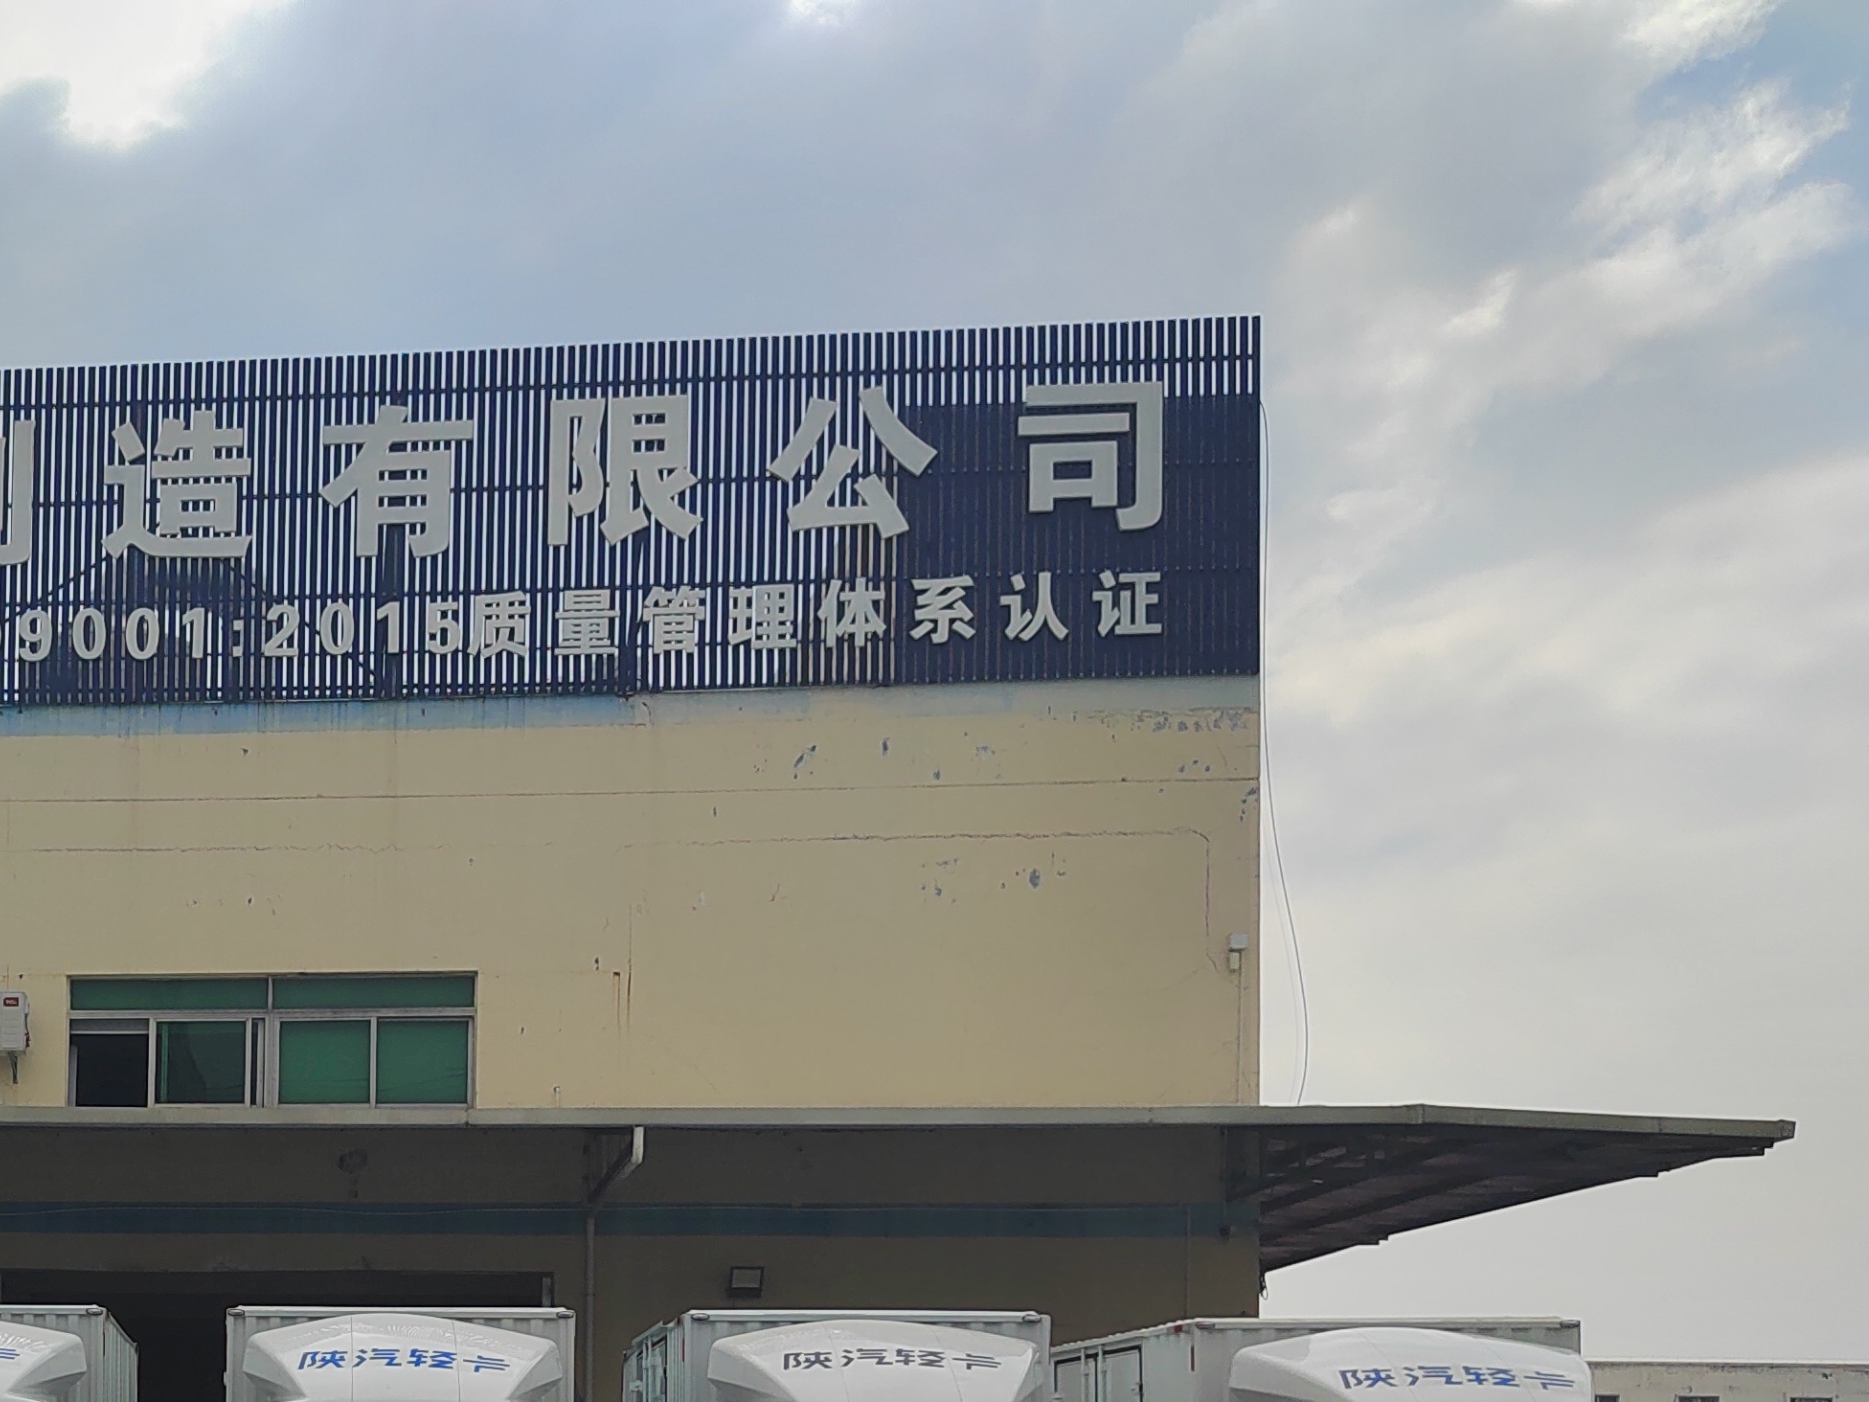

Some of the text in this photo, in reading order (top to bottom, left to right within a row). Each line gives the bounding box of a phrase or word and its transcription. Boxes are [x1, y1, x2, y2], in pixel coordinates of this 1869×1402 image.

[298, 1348, 510, 1372] 陕汽轻卡
[783, 1348, 1002, 1370] 陕汽轻卡
[1338, 1365, 1575, 1390] 陕汽轻卡
